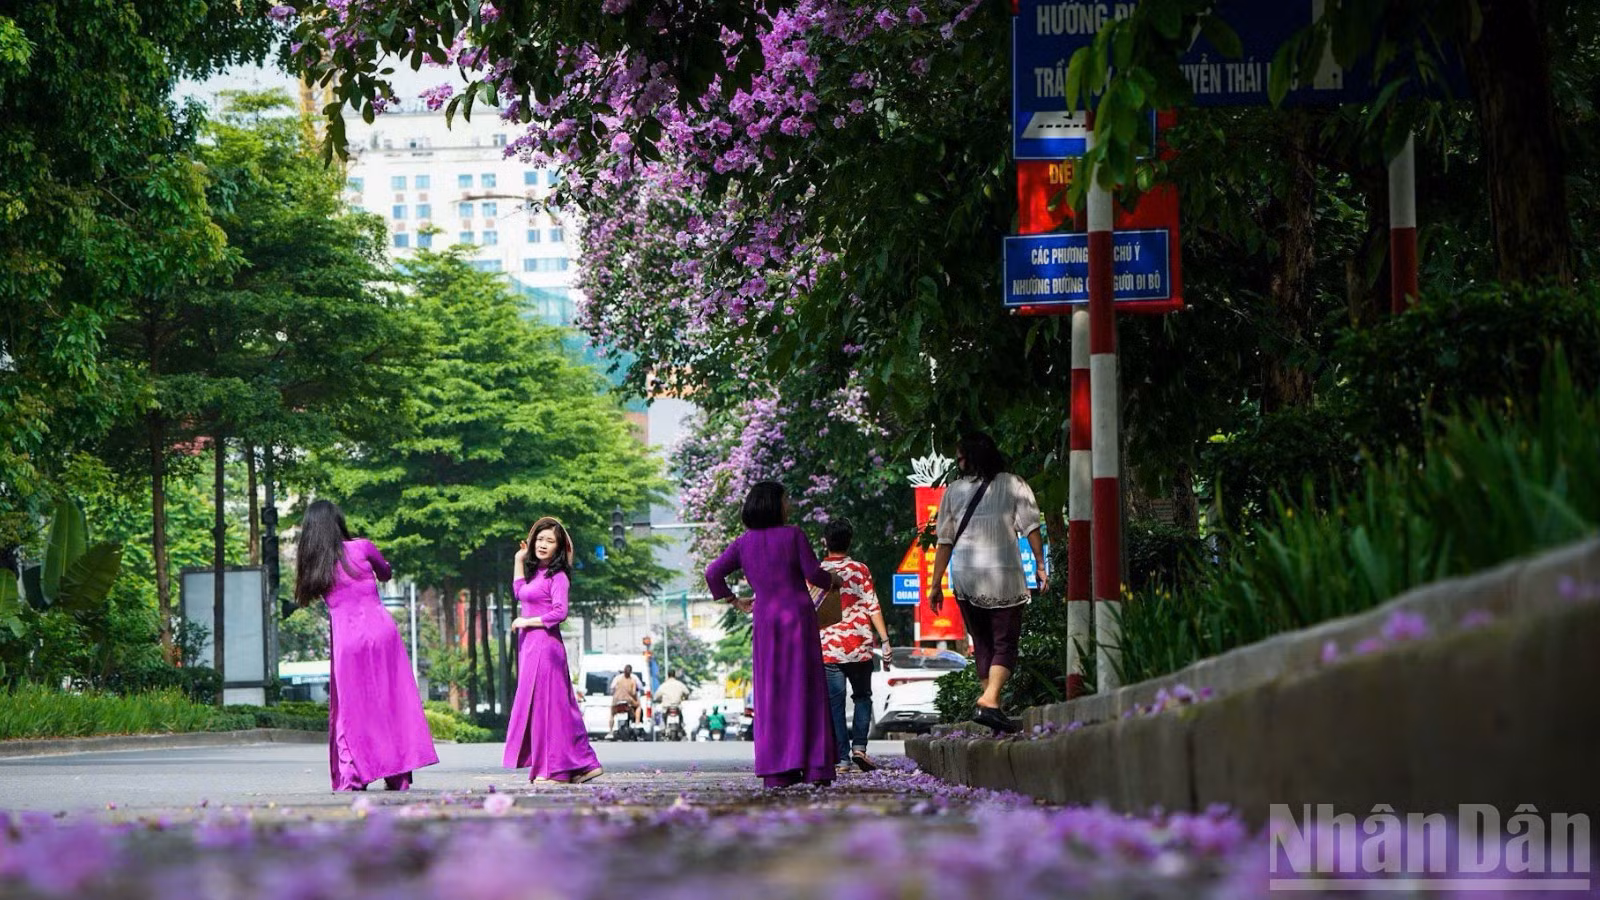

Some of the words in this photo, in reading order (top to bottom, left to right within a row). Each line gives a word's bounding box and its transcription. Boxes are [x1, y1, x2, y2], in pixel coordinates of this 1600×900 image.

[1031, 245, 1050, 265] CÁC
[1113, 242, 1132, 262] CHÚ
[1134, 241, 1141, 262] Ý
